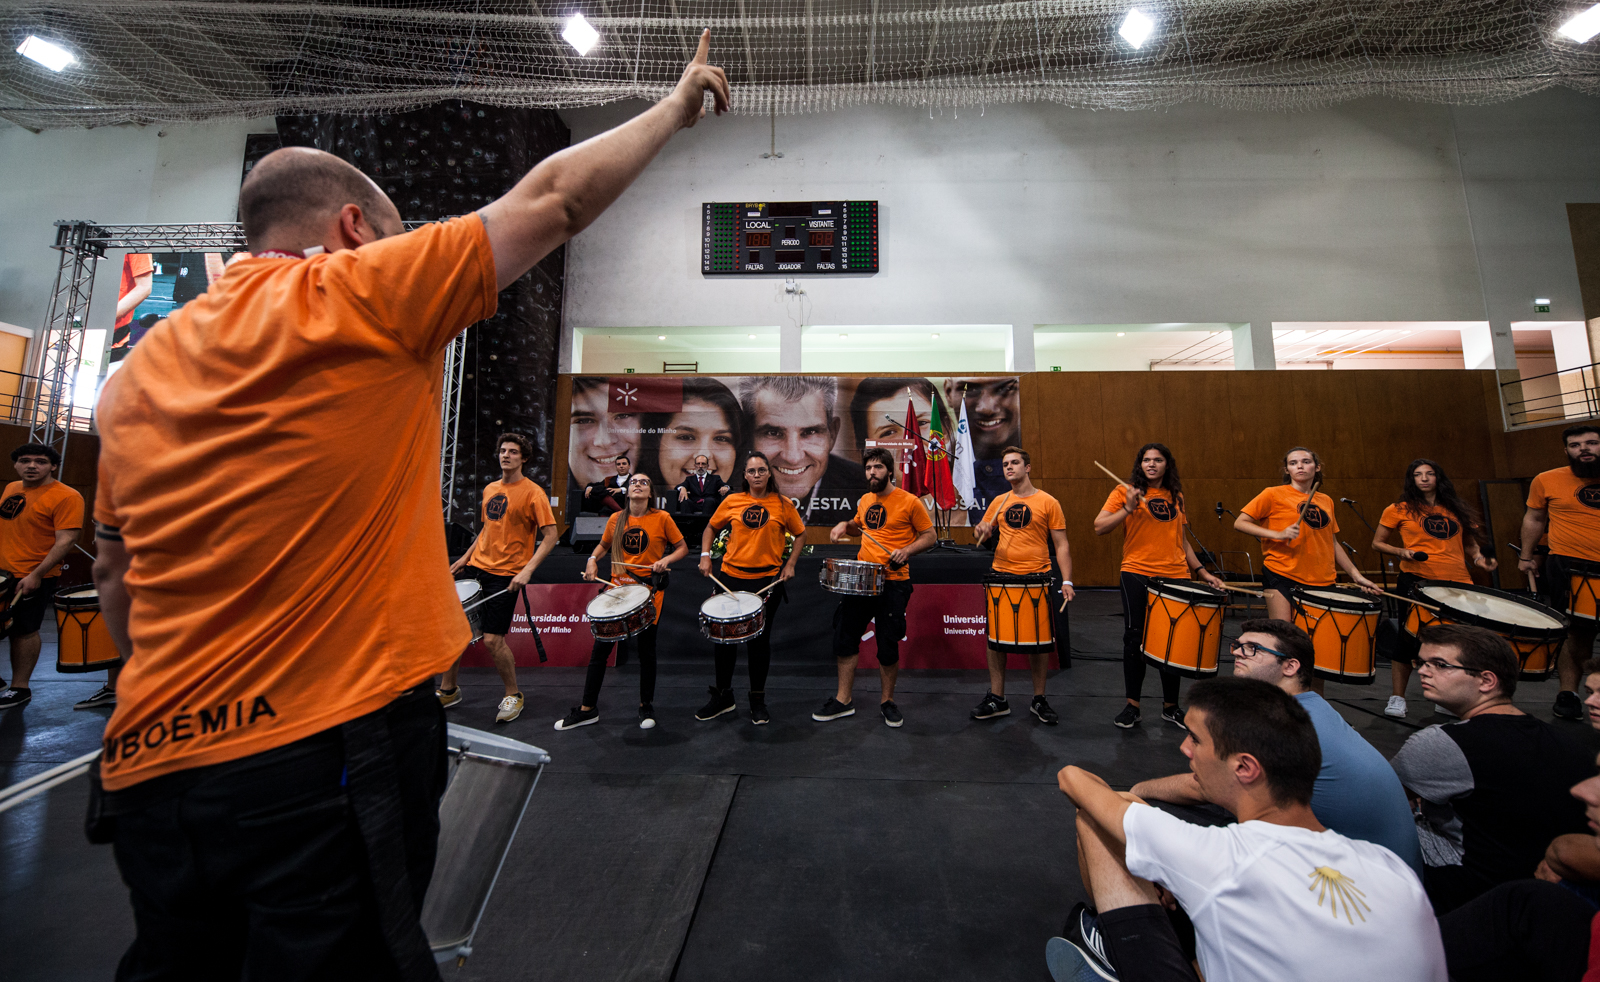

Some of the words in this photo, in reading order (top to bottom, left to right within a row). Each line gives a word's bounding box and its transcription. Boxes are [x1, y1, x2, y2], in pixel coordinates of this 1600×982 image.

[810, 498, 852, 510] ESTA
[512, 614, 566, 622] Uniersidade
[568, 614, 580, 622] do
